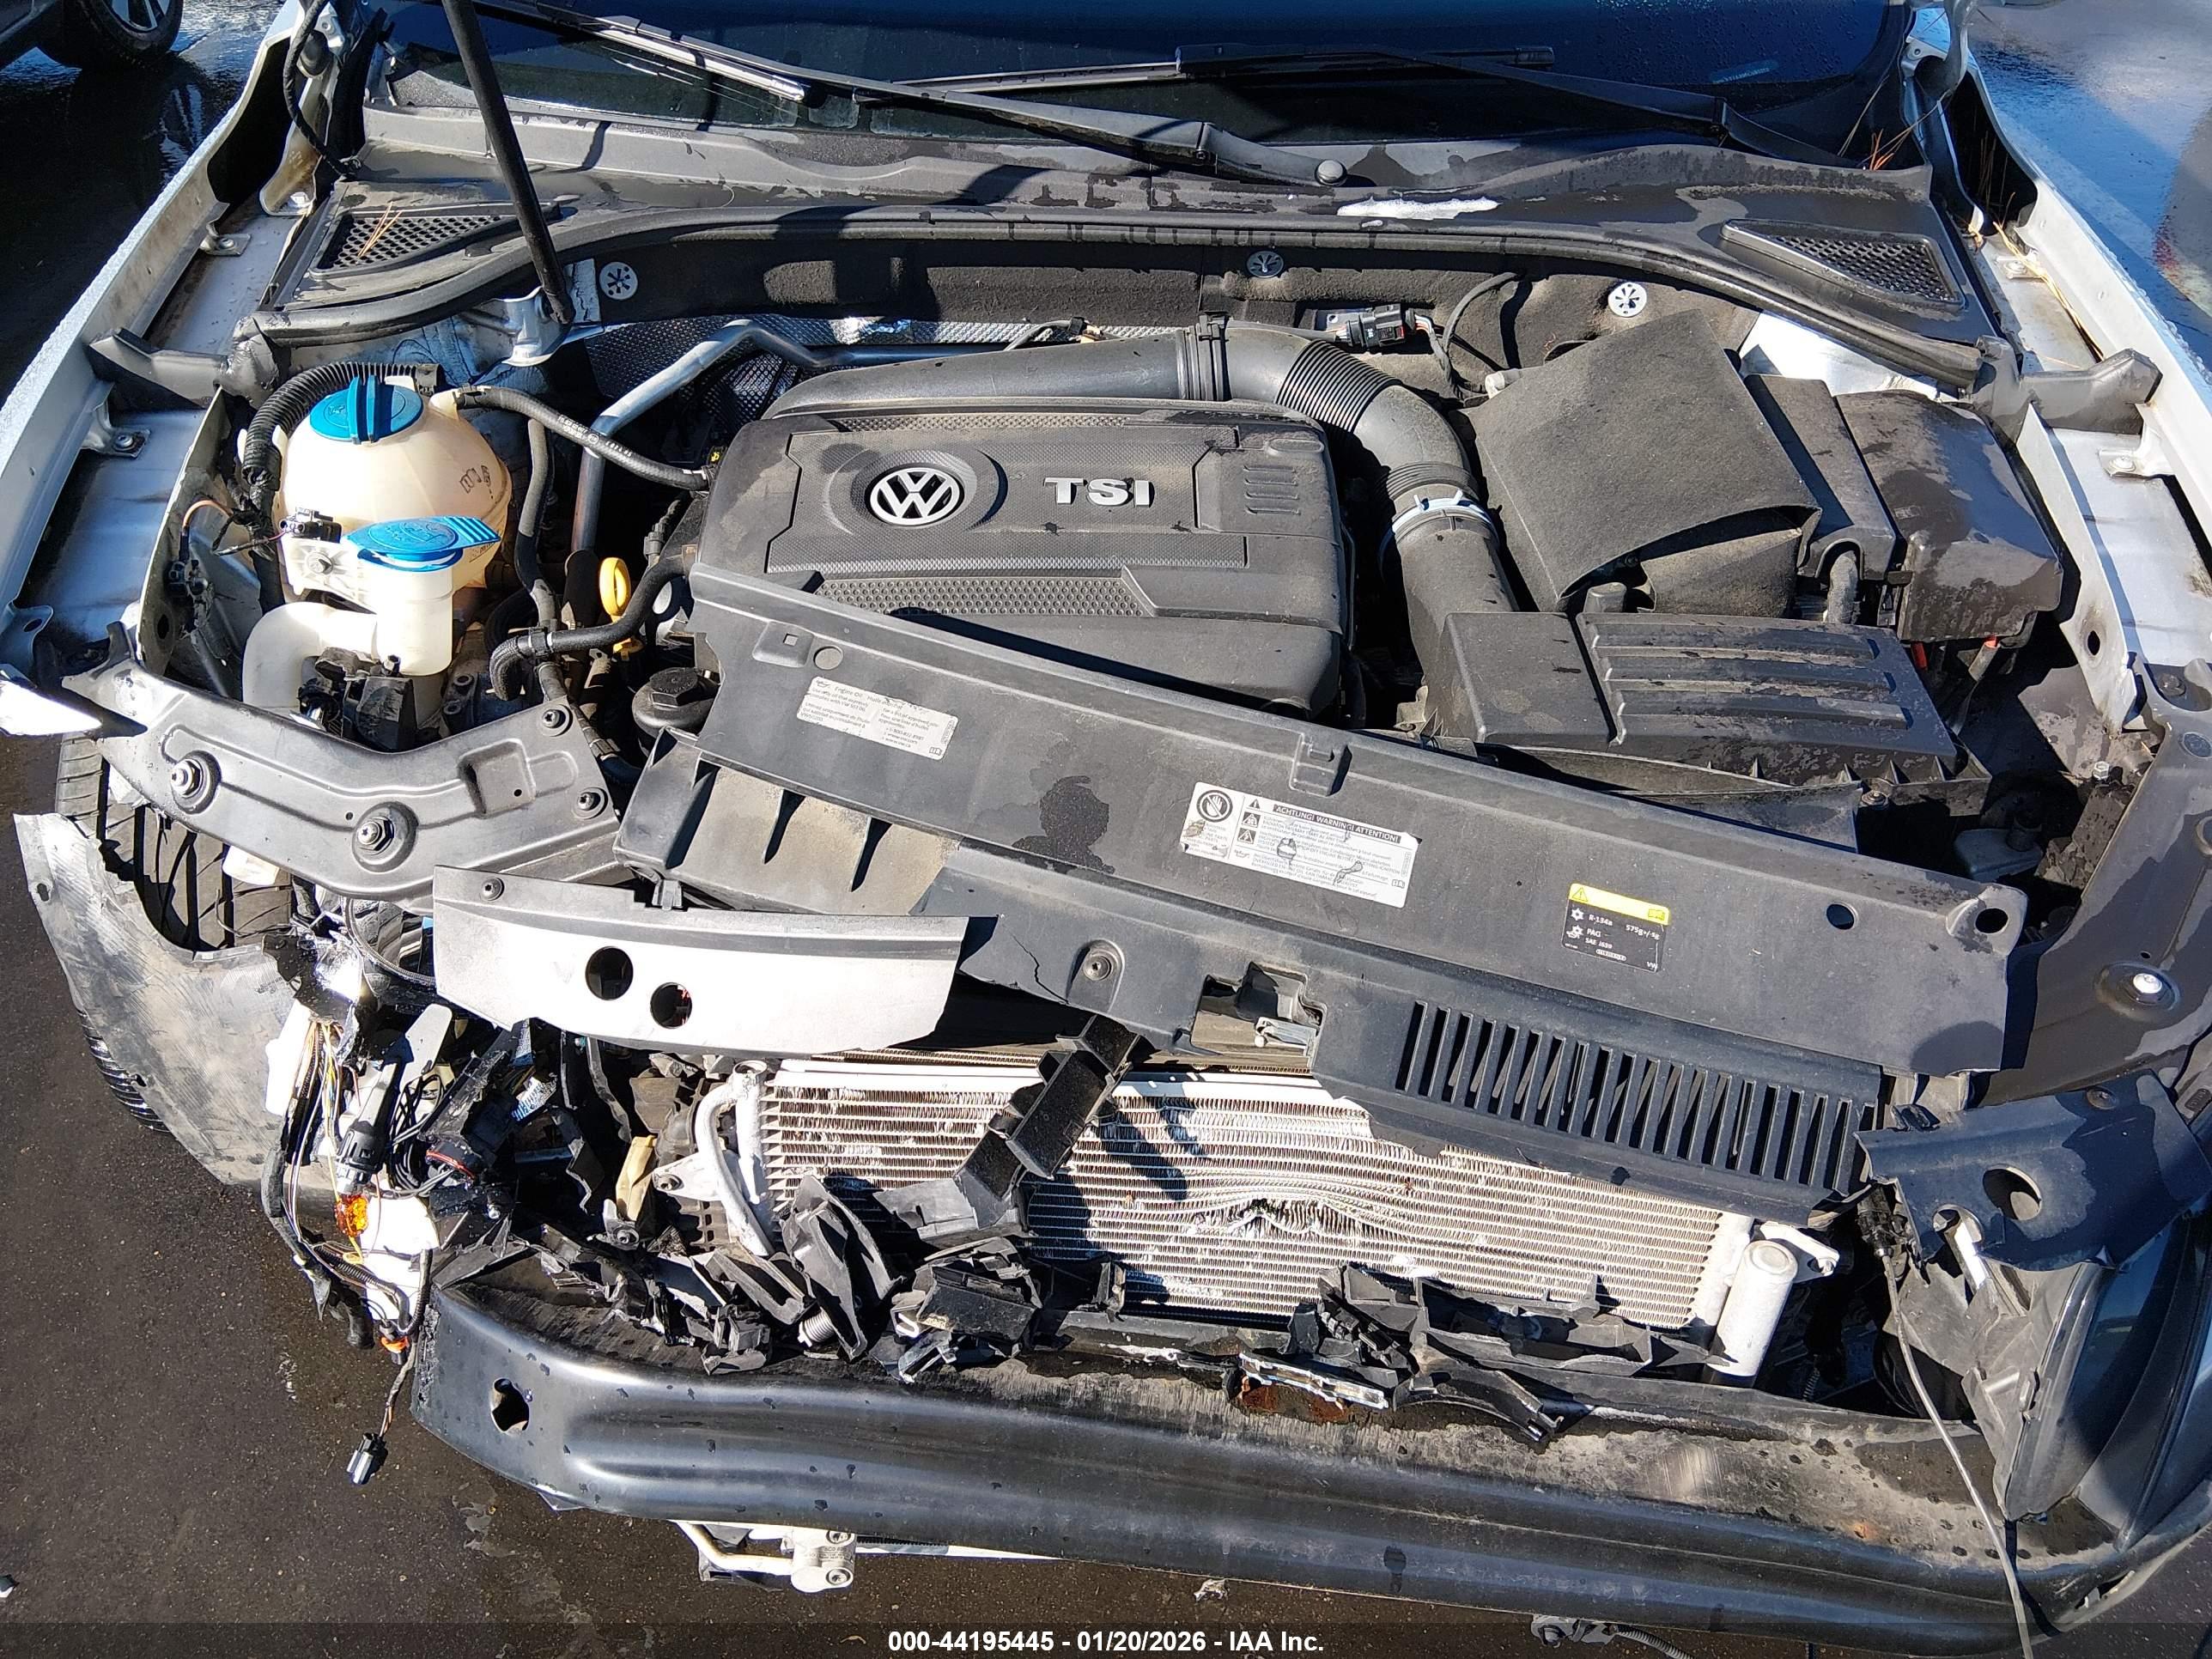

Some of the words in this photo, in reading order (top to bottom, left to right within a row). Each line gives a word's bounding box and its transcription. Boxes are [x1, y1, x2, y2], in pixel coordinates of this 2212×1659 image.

[1044, 477, 1152, 507] TSI
[834, 685, 854, 696] Engine
[1275, 805, 1315, 820] ACHTUNG!
[1315, 815, 1354, 830] WARNING!
[1354, 826, 1398, 842] ATTENTION!
[1588, 914, 1613, 926] R-134a
[1586, 928, 1601, 938] PAG
[1585, 937, 1597, 945] SAE
